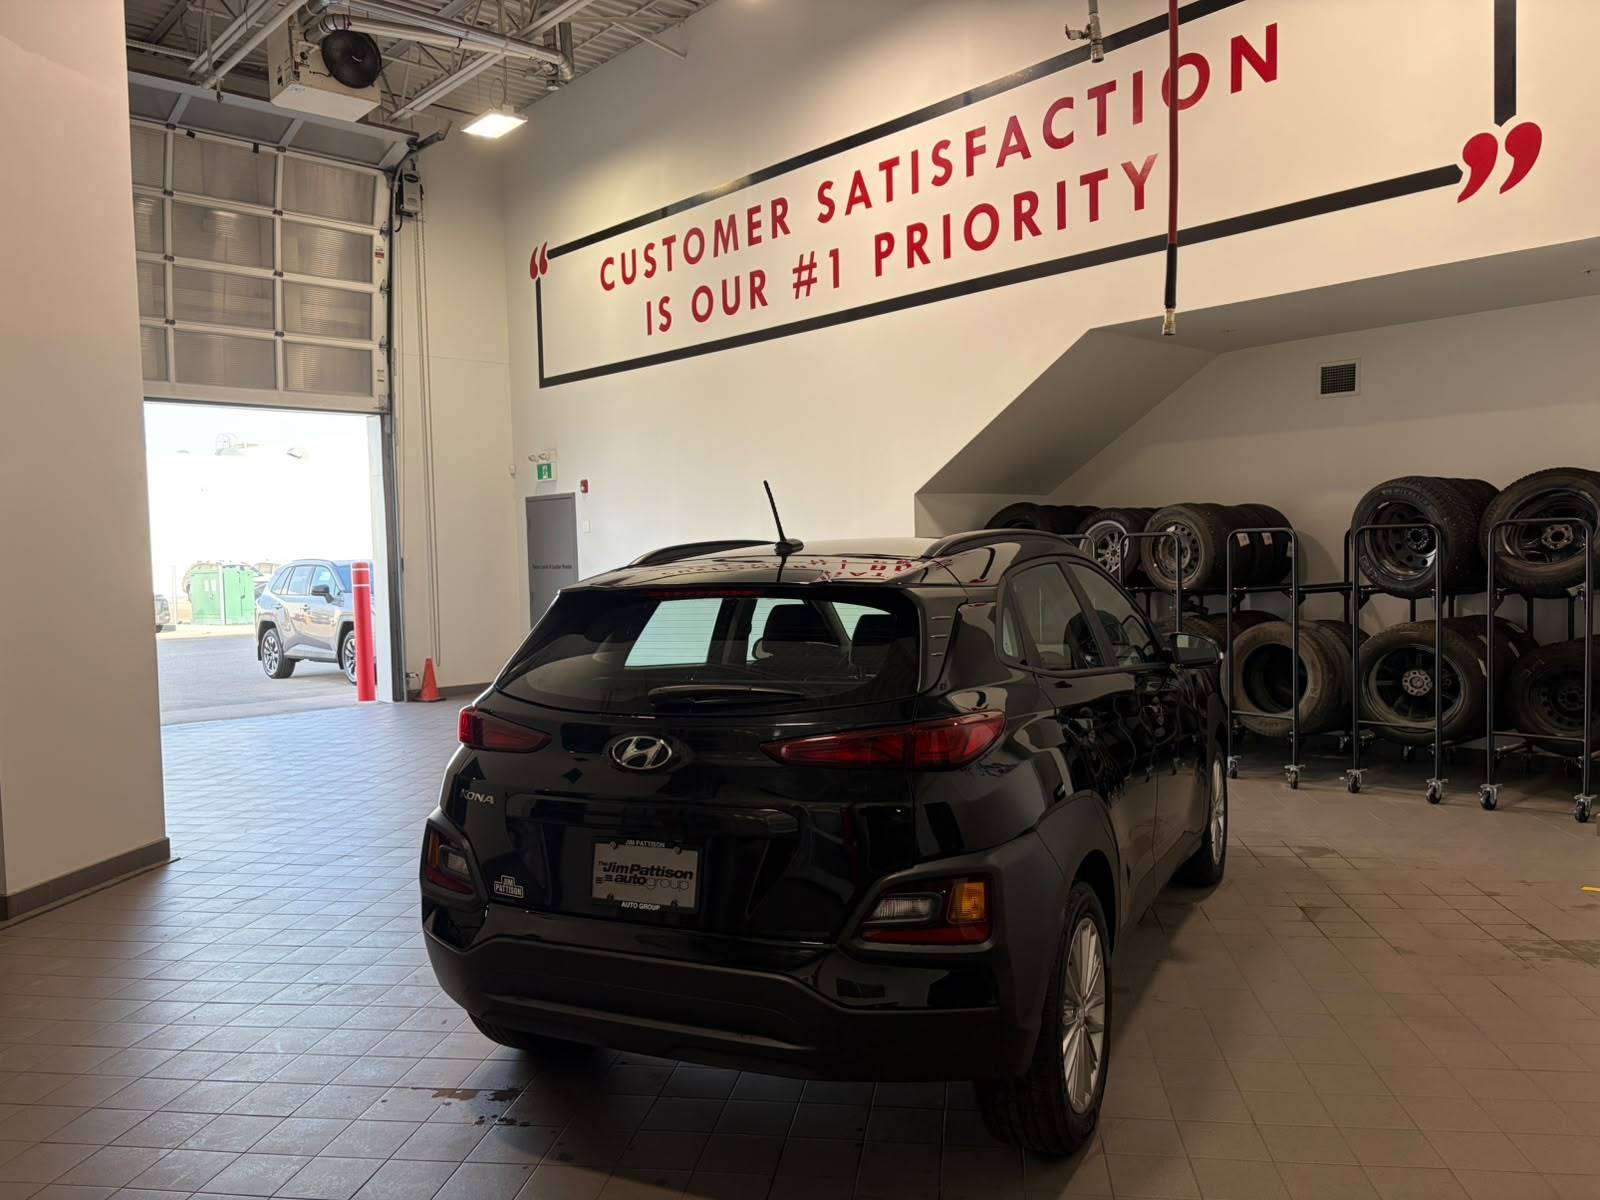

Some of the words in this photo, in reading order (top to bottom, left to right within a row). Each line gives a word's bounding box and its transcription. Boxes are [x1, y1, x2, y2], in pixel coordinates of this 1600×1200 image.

[600, 196, 791, 292] CUSTOMER
[816, 21, 1279, 225] SATISFACTION
[645, 295, 673, 336] IS
[691, 268, 769, 324] OUR
[792, 247, 841, 300] #1
[873, 154, 1157, 278] PRIORITY
[460, 788, 495, 804] KONA
[495, 883, 523, 896] PATTISON
[621, 901, 638, 909] AUTO
[638, 903, 661, 911] GROUP
